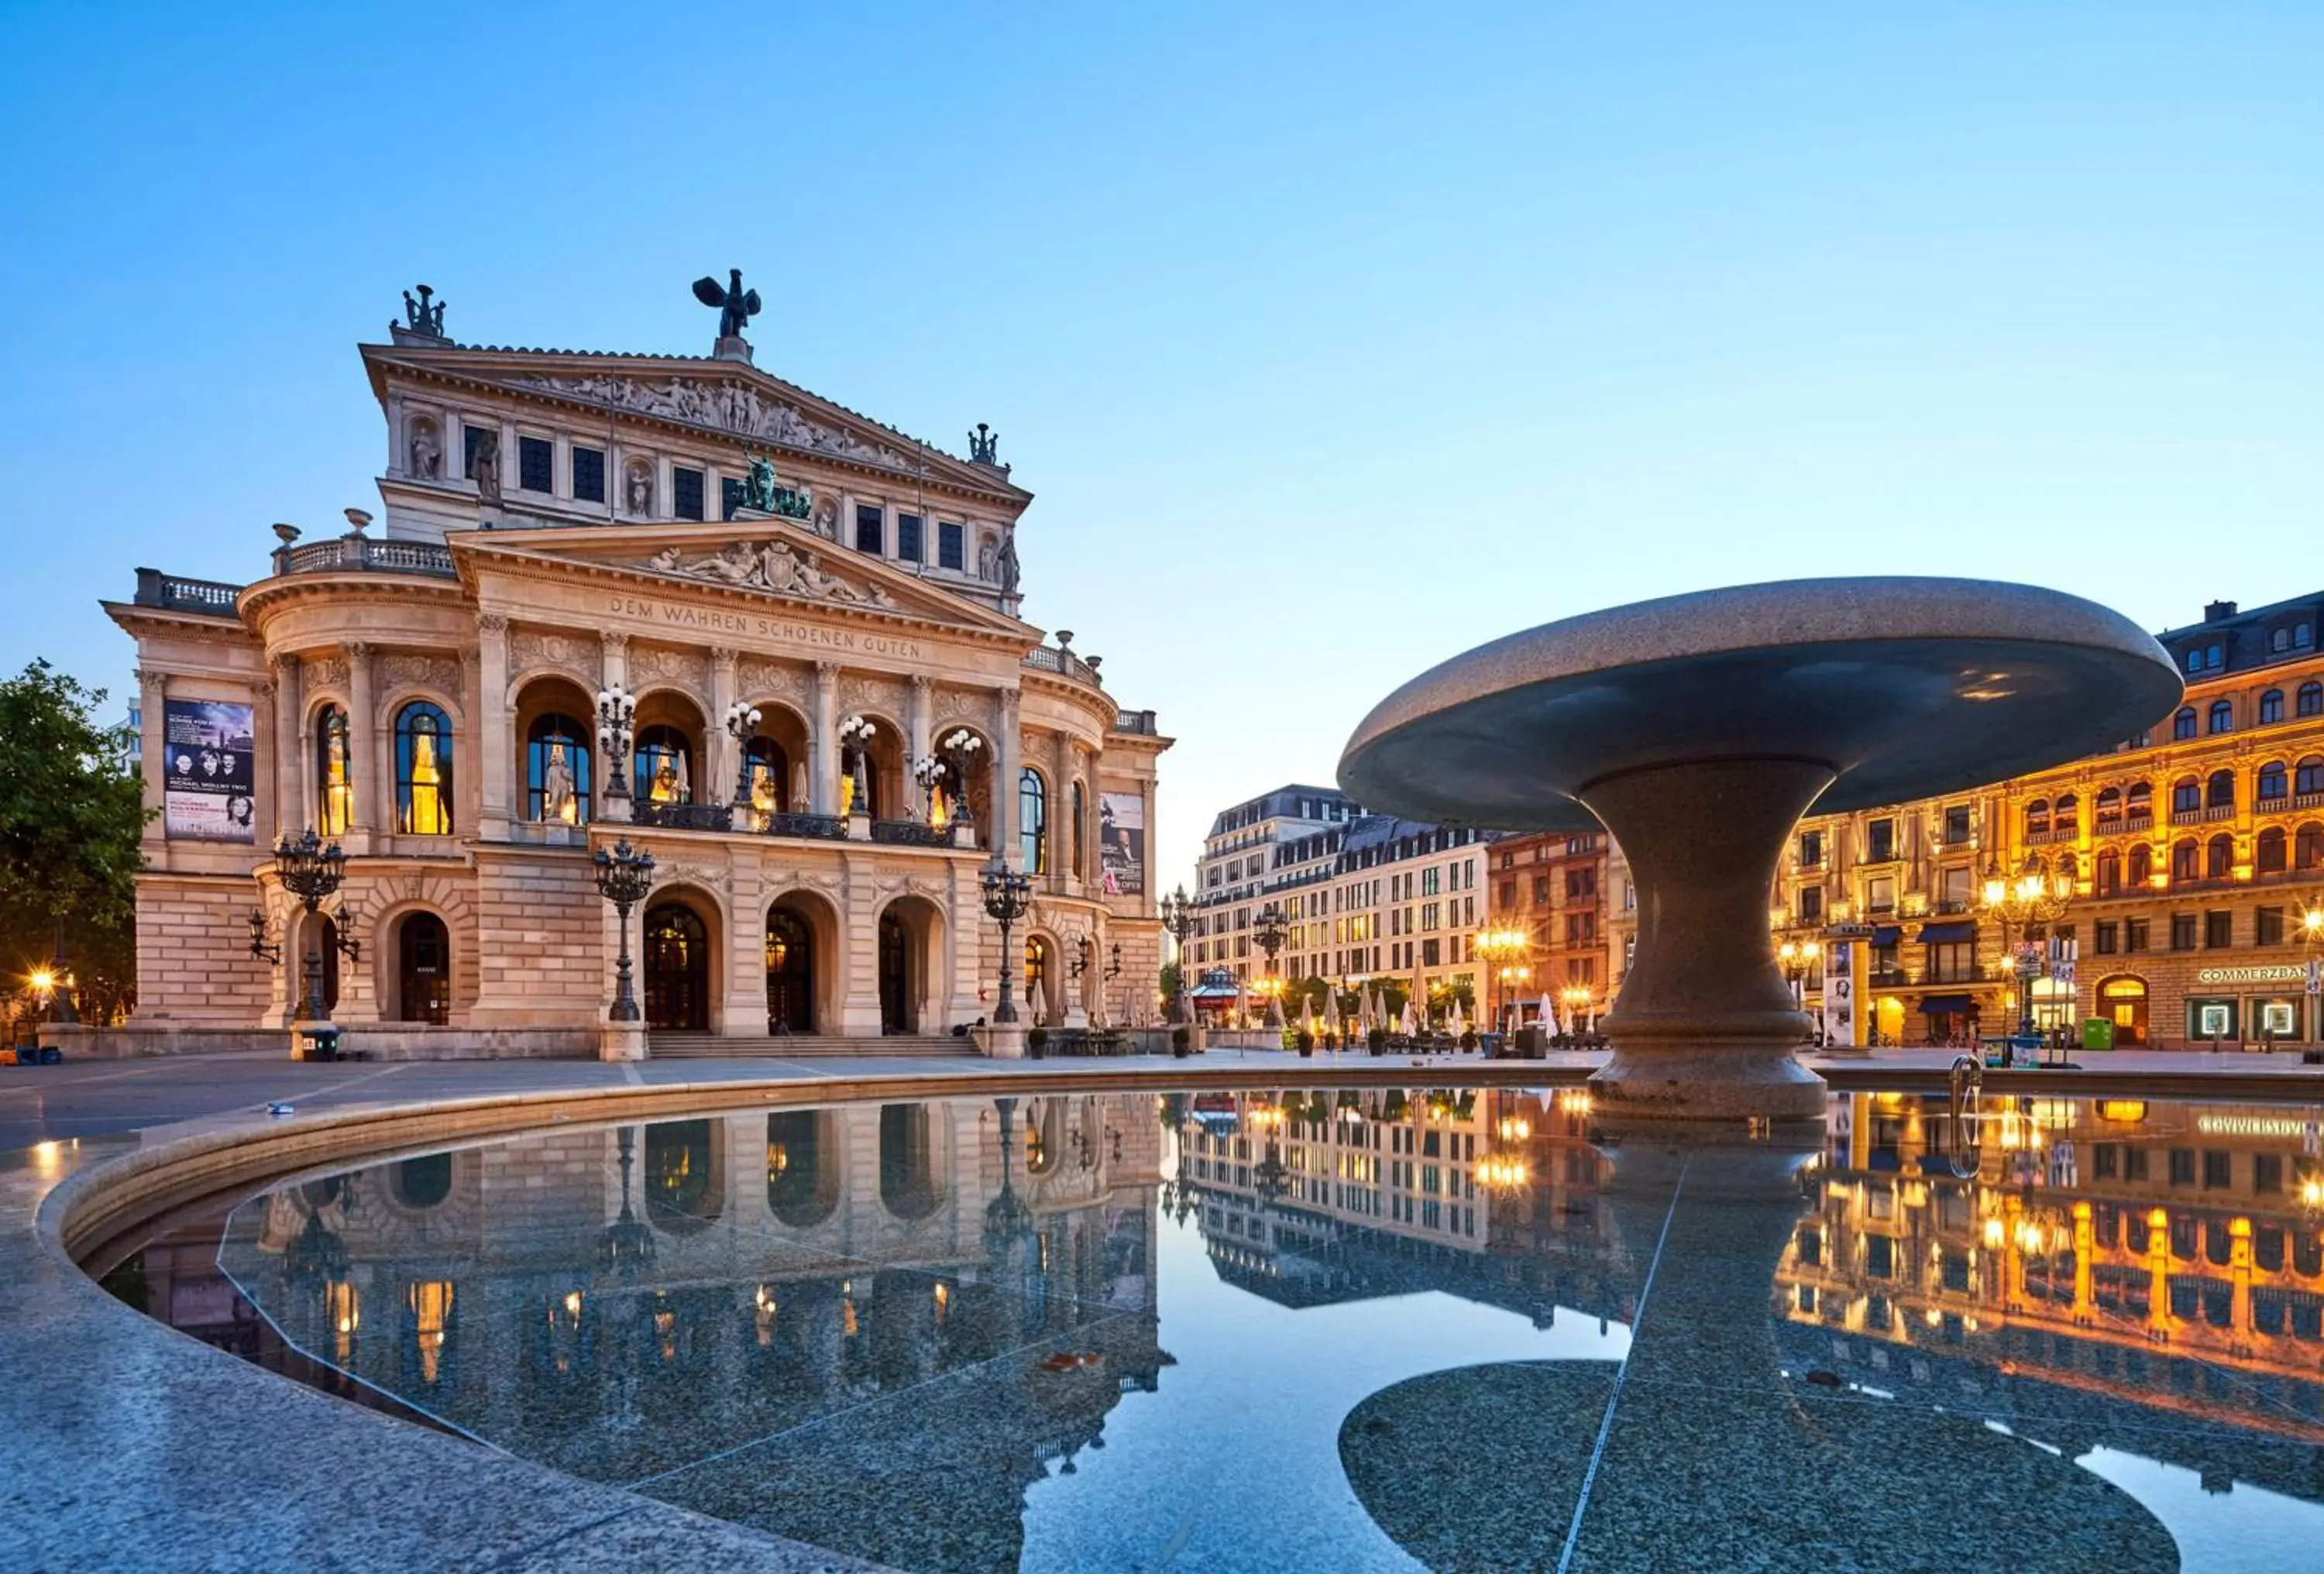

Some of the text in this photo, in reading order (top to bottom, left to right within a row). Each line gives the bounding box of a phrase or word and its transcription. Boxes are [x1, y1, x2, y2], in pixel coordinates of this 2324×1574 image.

[611, 598, 652, 617] DEM
[663, 605, 747, 631] WAHREN
[758, 620, 854, 647] SCHOENEN
[2201, 967, 2307, 981] COMMERZBAN
